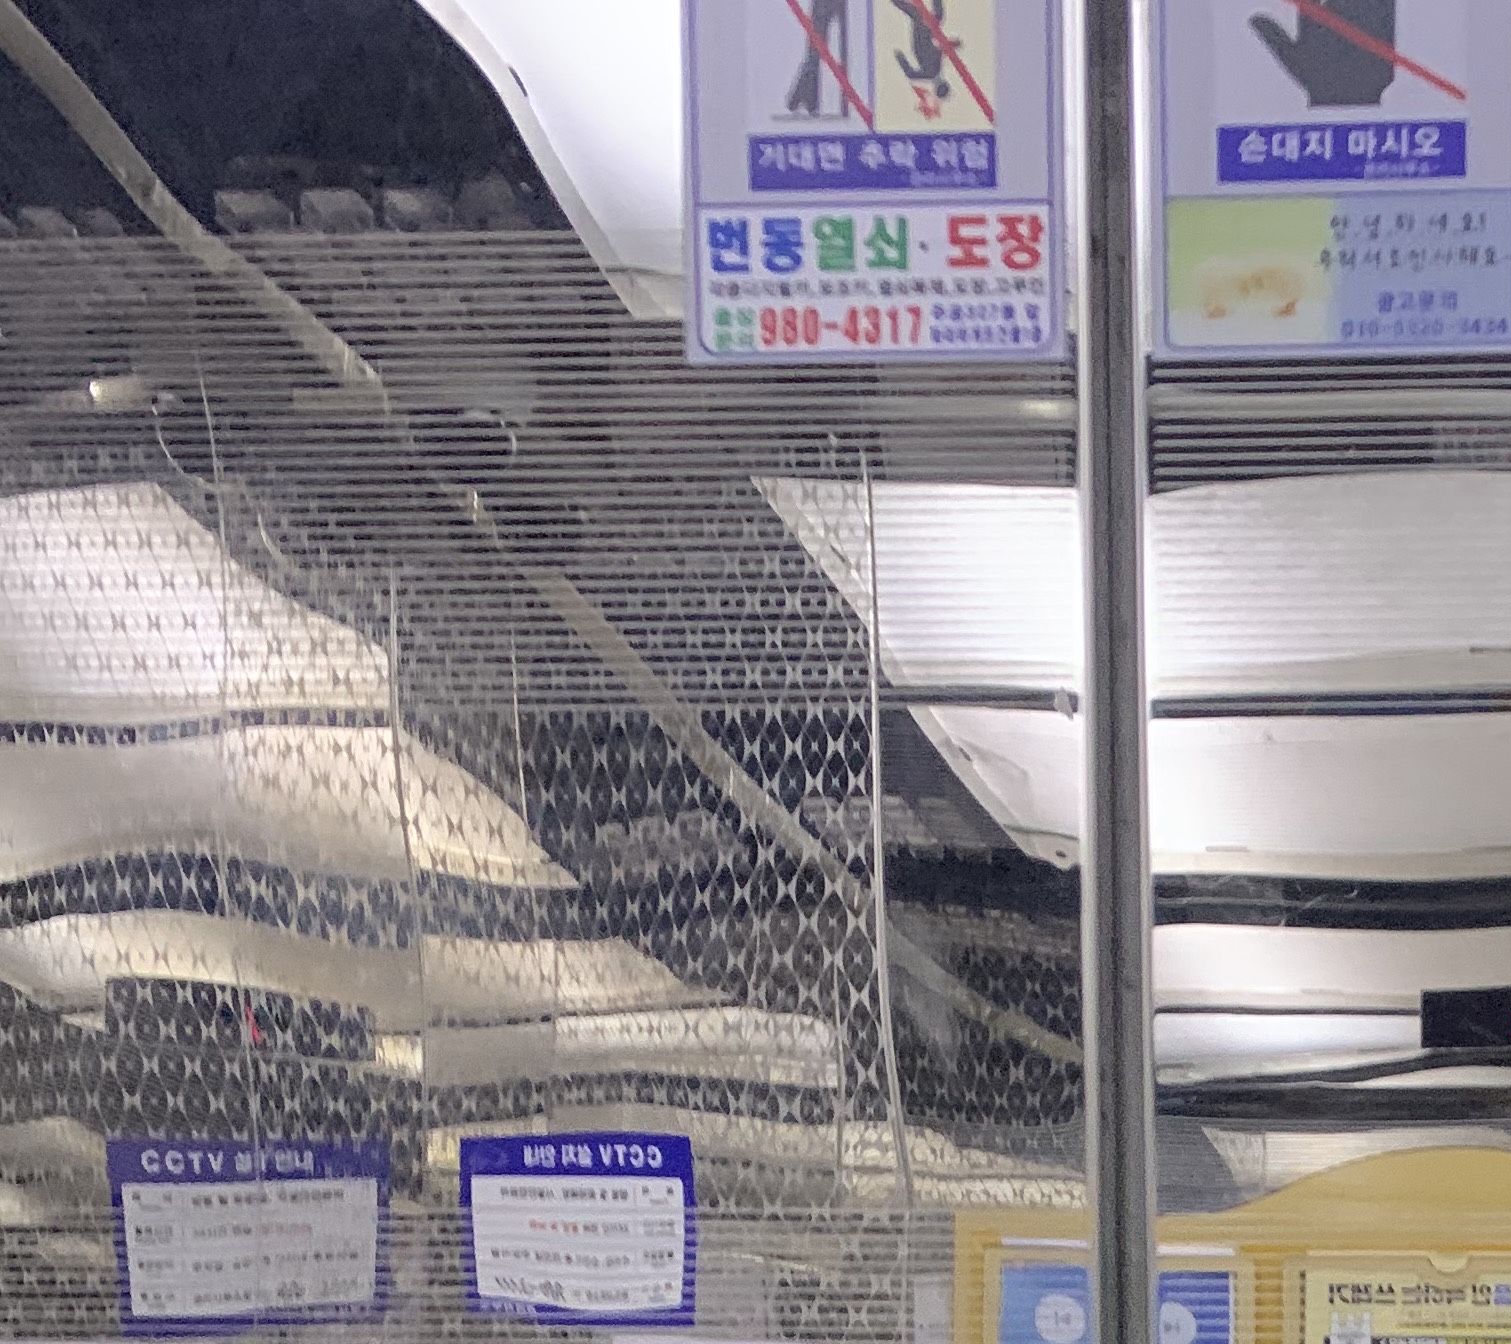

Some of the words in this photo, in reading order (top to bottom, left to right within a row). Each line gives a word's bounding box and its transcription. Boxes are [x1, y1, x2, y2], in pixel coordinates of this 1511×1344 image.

[758, 139, 847, 172] 기대면
[857, 138, 918, 171] 추락
[930, 137, 989, 170] 위험
[1238, 127, 1335, 163] 손대지
[1347, 124, 1444, 159] 마시오
[949, 215, 1043, 270] 도장
[759, 305, 922, 346] 980-4317
[140, 1148, 226, 1175] CCTV
